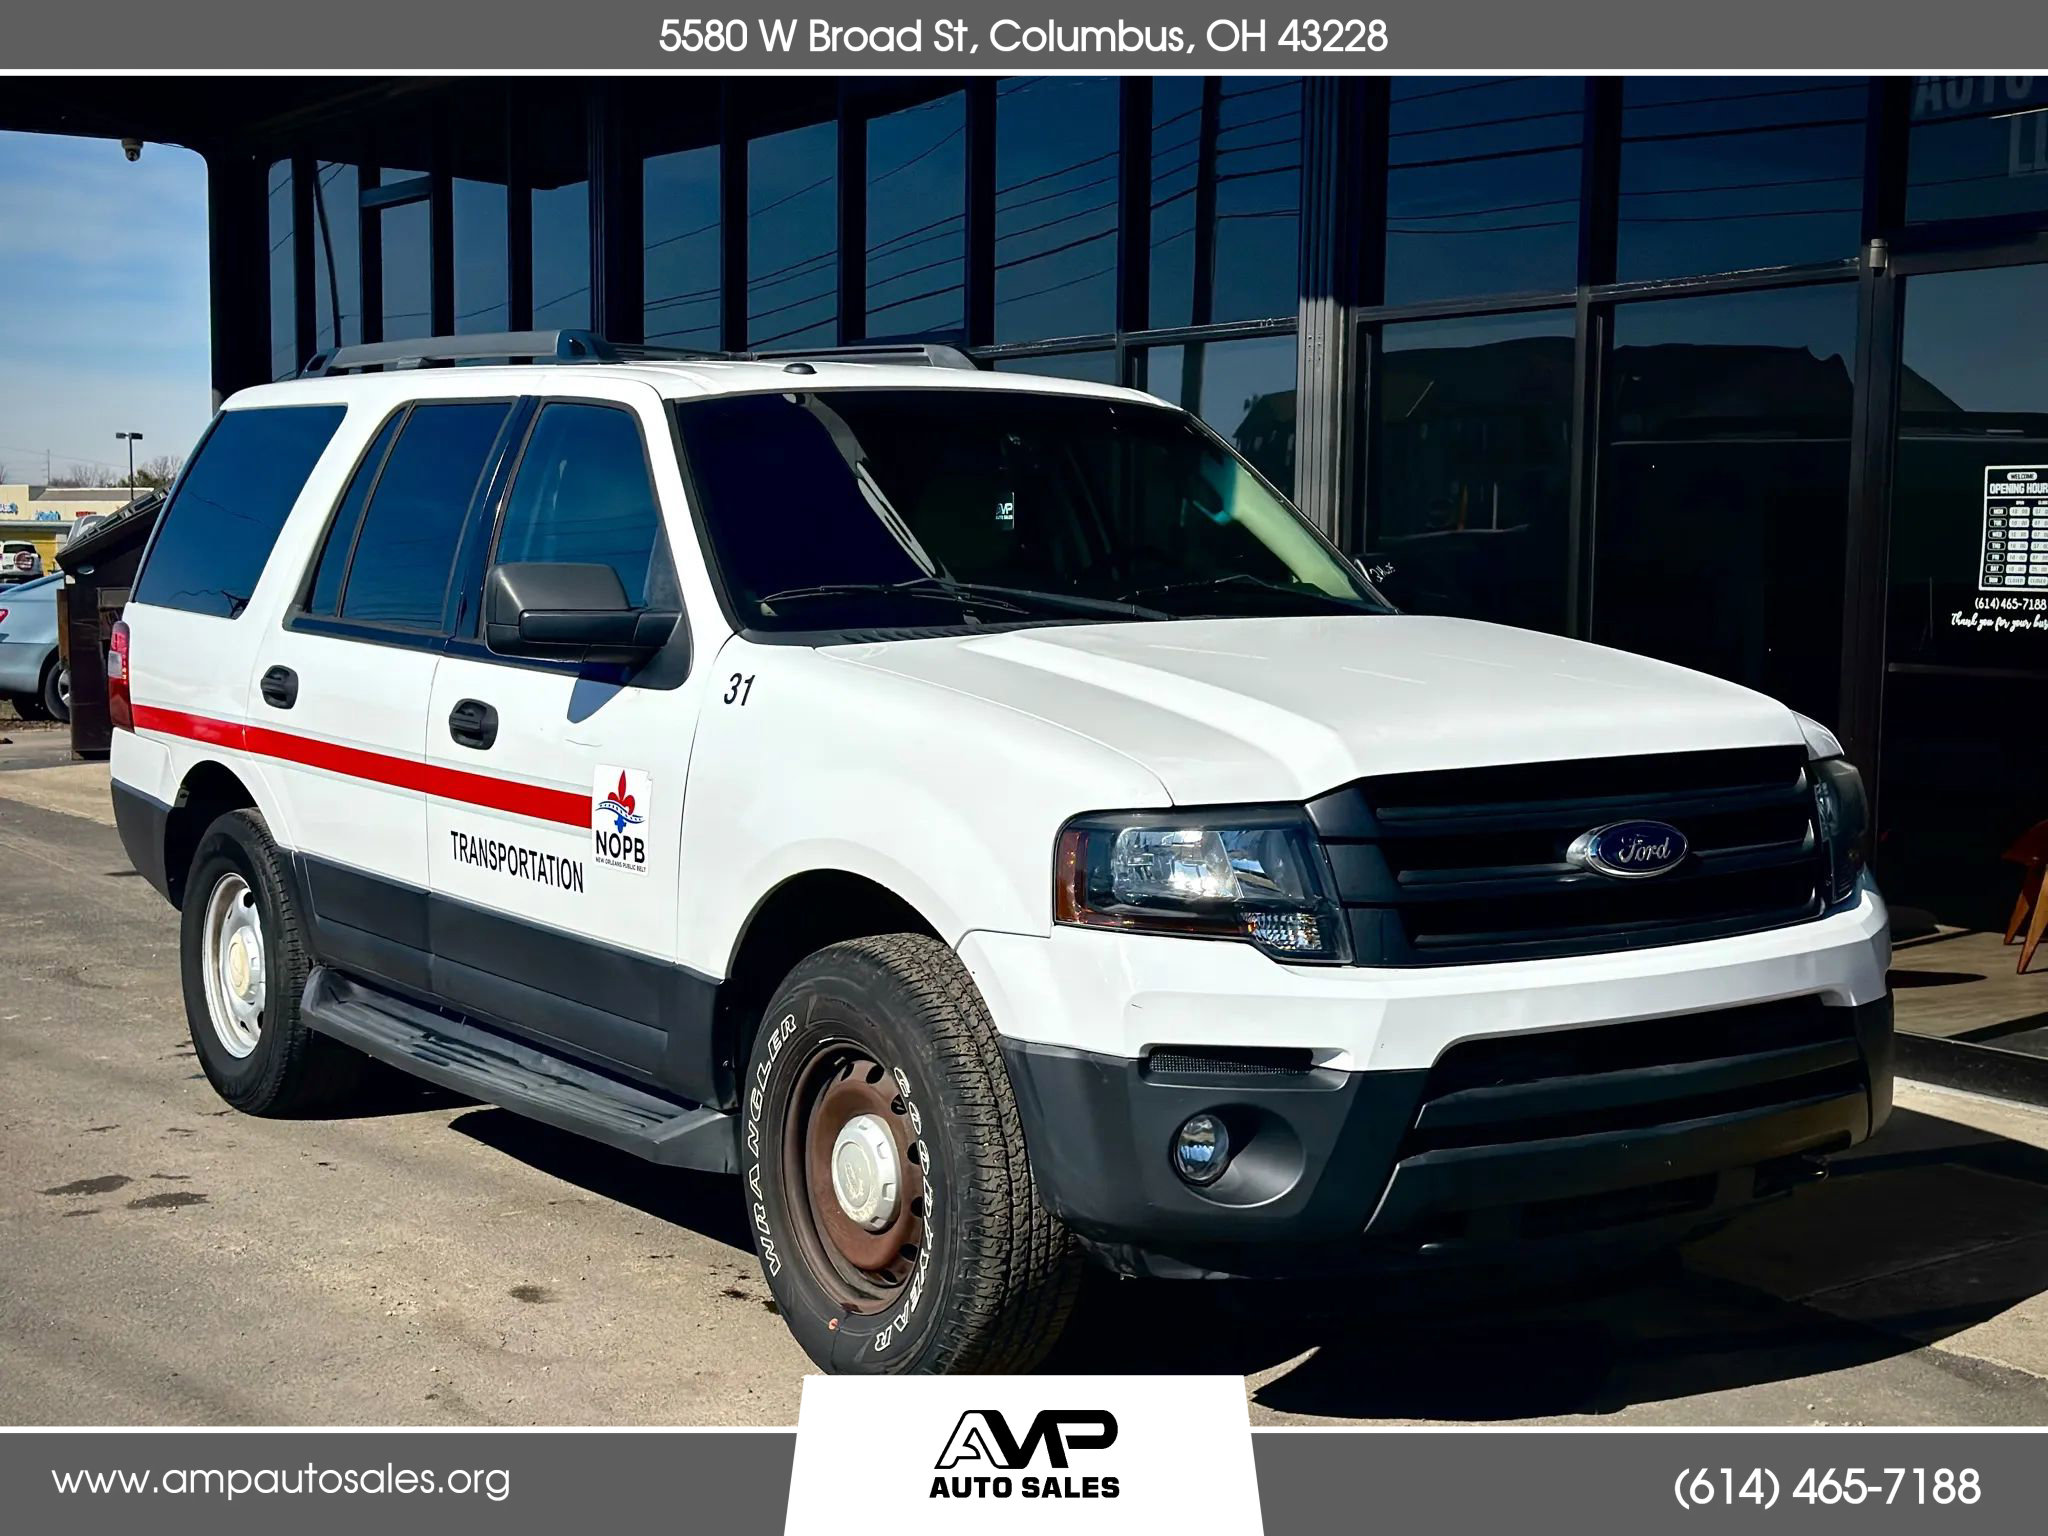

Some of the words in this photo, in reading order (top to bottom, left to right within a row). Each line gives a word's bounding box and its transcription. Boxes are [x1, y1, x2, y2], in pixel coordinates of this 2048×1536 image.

[1989, 483, 2025, 495] OPENING
[1951, 610, 1979, 628] Thank
[1976, 618, 1995, 632] you
[1994, 616, 2010, 632] for
[723, 672, 756, 707] 31
[450, 830, 584, 894] TRANSPORTATION
[595, 829, 646, 864] NOPB
[1618, 832, 1672, 863] Ford
[747, 1013, 797, 1278] WRANGLER
